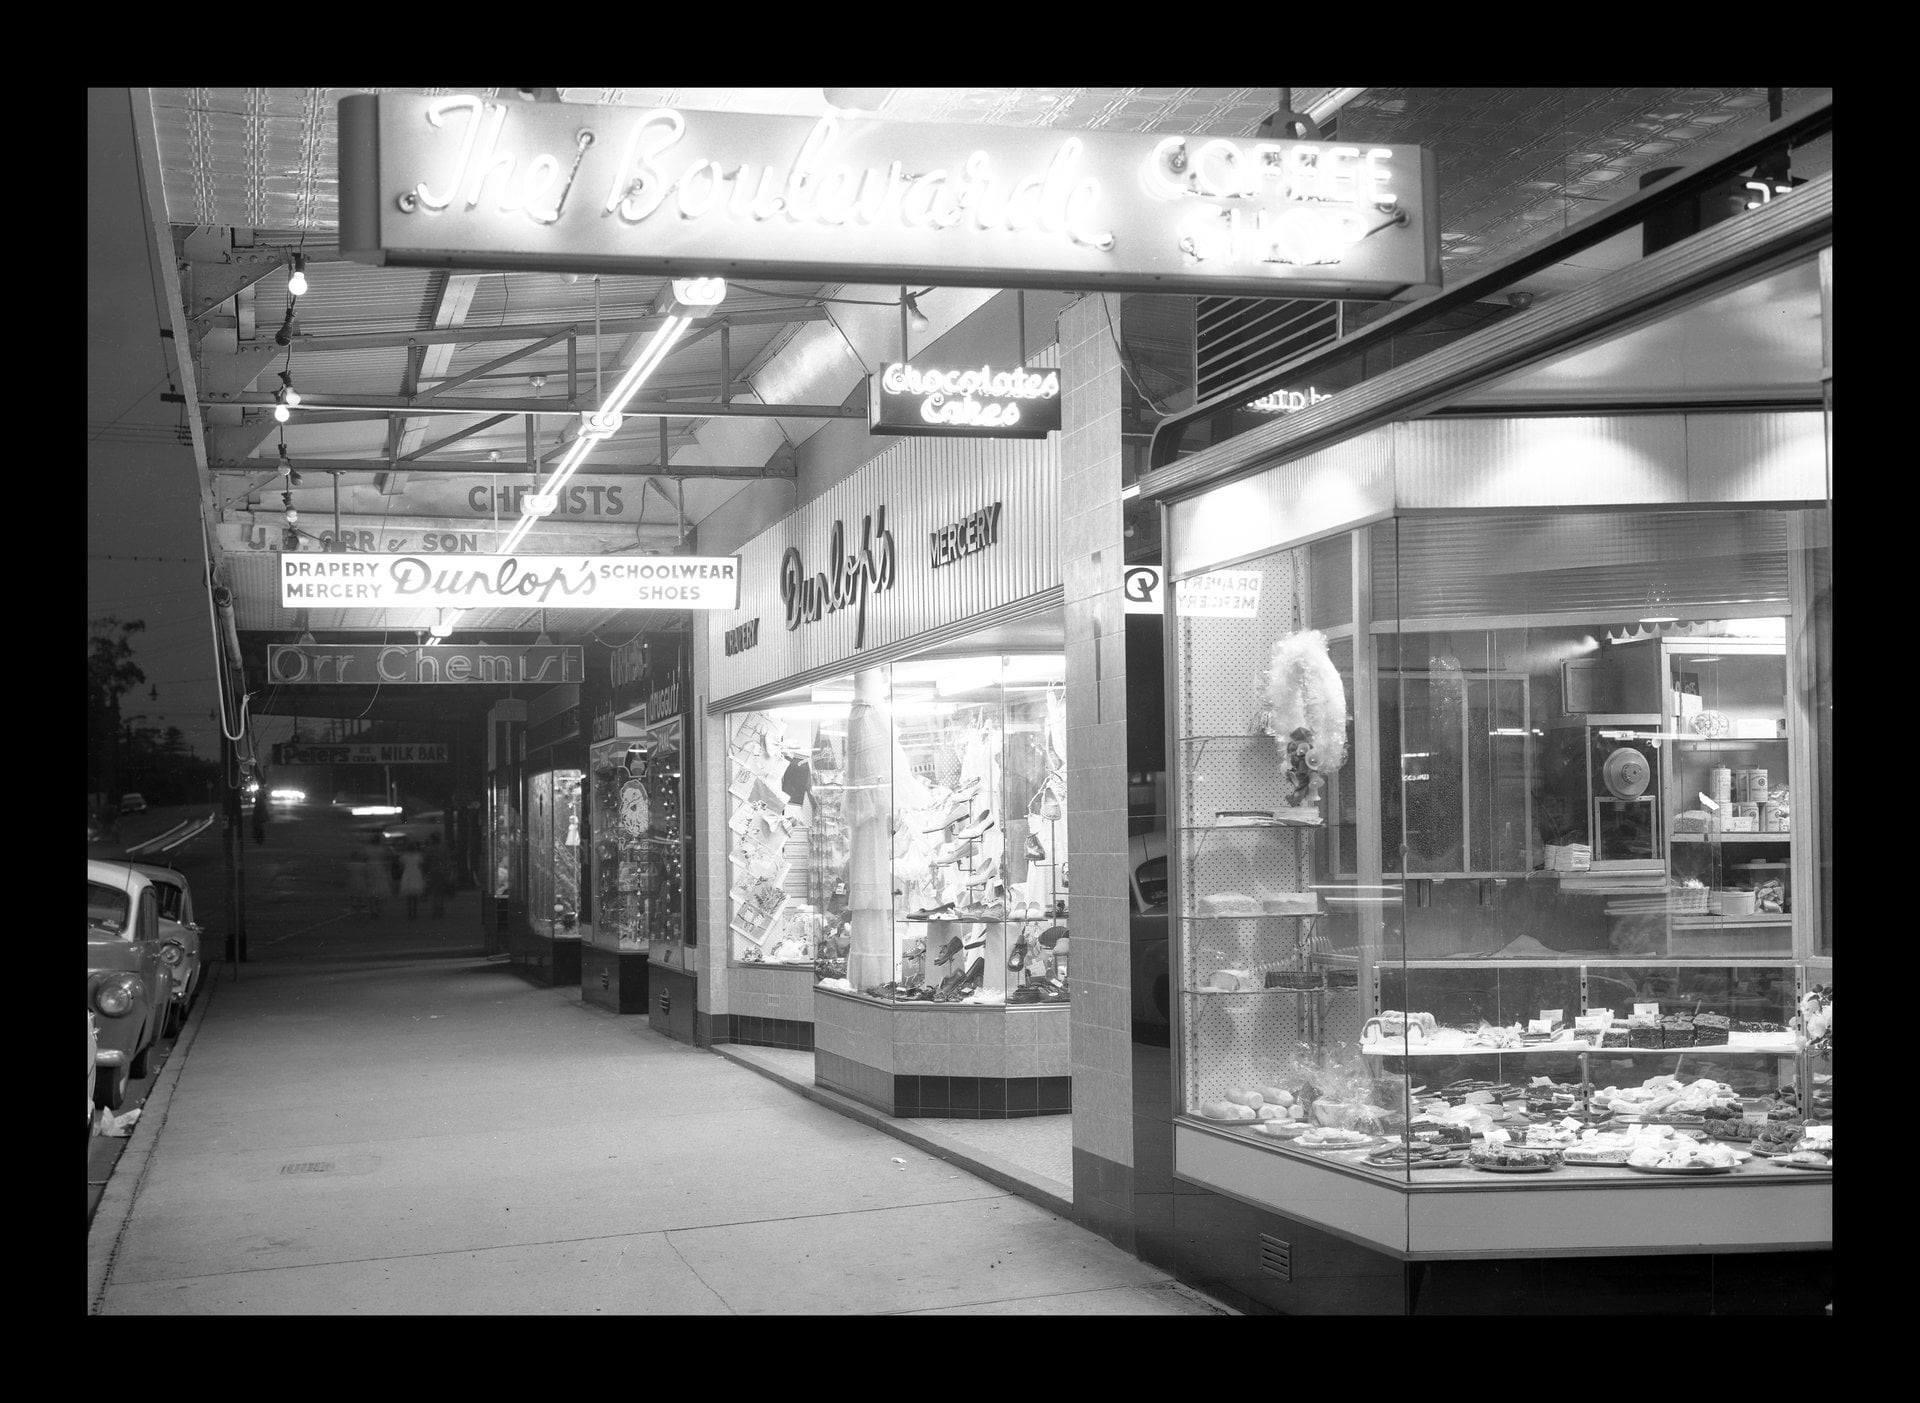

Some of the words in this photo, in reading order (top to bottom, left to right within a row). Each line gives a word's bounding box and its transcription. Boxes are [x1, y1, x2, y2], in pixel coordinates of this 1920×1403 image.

[416, 95, 560, 224] The
[1150, 136, 1398, 203] COFFEE
[1178, 204, 1369, 264] SHOP
[883, 363, 1059, 399] Chocolates
[920, 395, 1021, 427] Cakes
[388, 538, 408, 552] &
[423, 533, 478, 553] SON
[929, 502, 1001, 568] MERCERY
[285, 562, 380, 577] DRAPERY
[390, 557, 596, 602] Dunlop's
[601, 564, 734, 580] SCHOOLWEAR
[780, 504, 895, 650] Dunlop's
[286, 583, 383, 598] MERCERY
[639, 586, 700, 600] SHOES
[271, 645, 354, 682] Orr
[377, 645, 578, 682] Chemist
[381, 746, 414, 762] MILK
[418, 746, 446, 762] BAR
